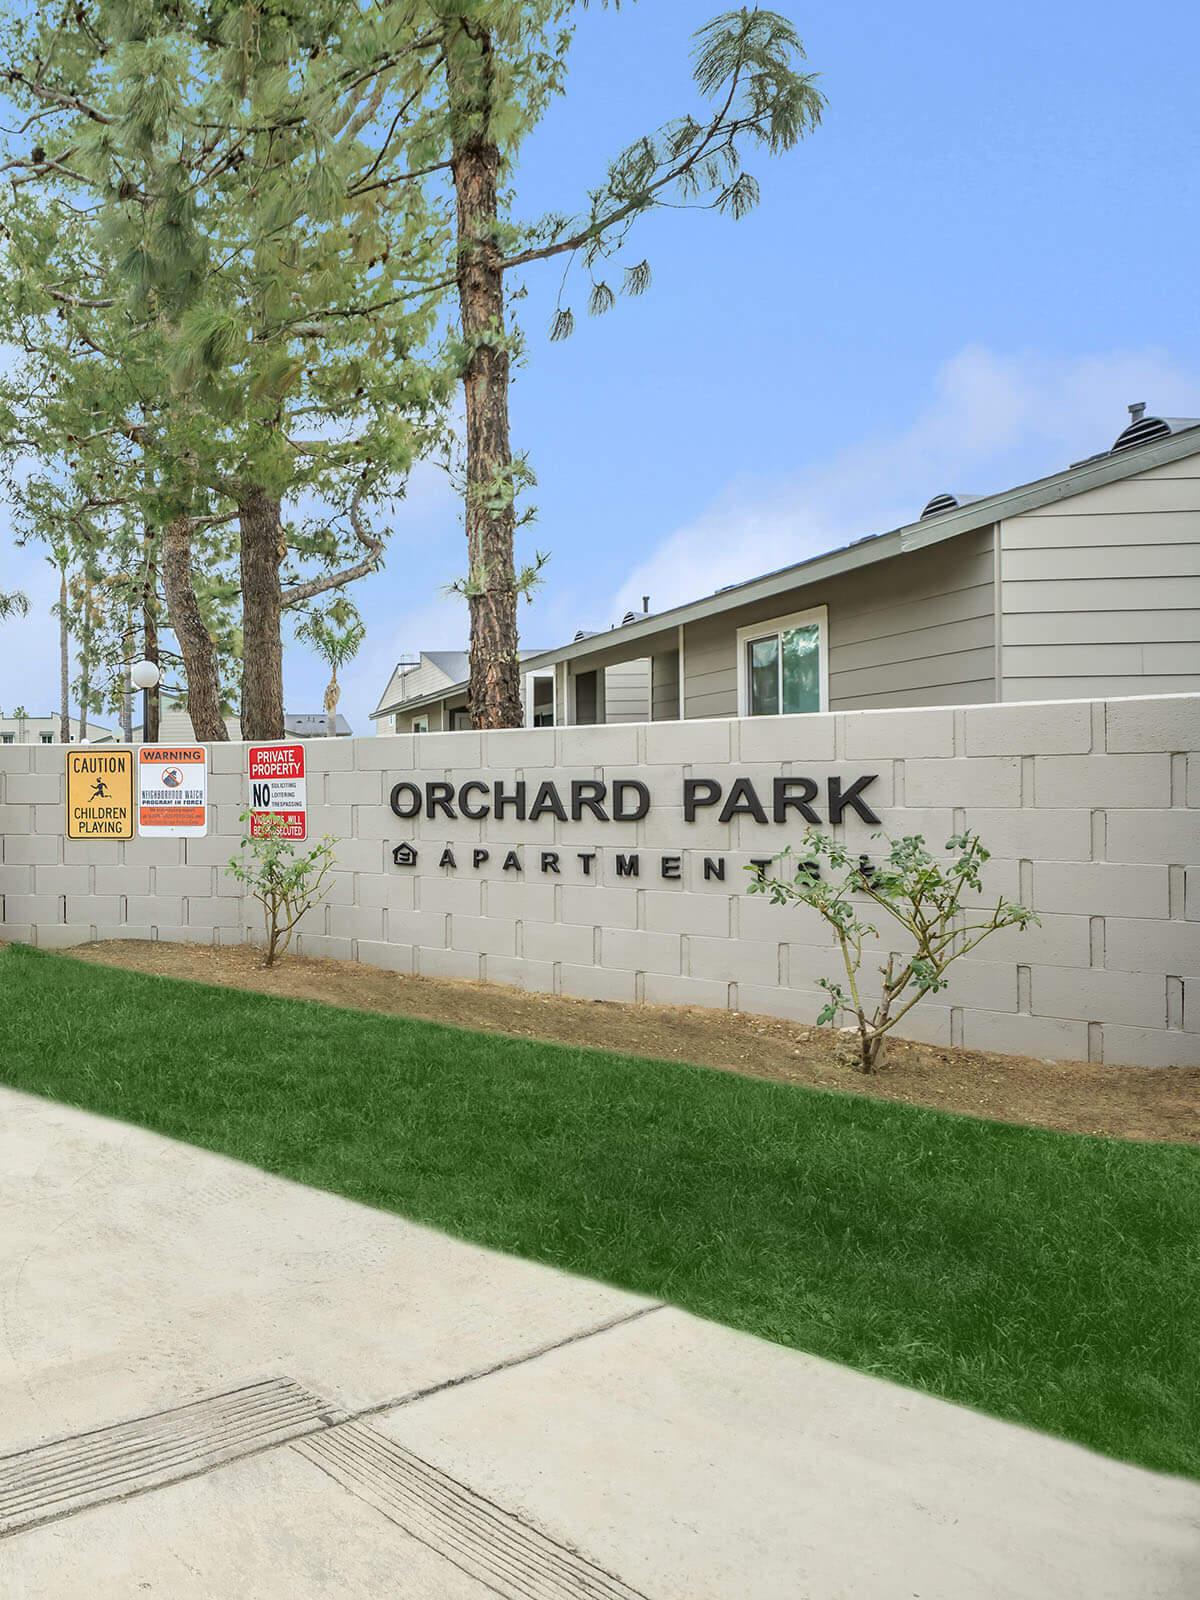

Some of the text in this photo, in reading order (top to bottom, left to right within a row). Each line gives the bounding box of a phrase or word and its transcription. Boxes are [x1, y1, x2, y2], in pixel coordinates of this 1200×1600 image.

[144, 752, 201, 760] WARNING
[258, 750, 294, 763] PRIVATE
[74, 758, 125, 773] CAUTION
[252, 763, 300, 776] PROPERTY
[142, 791, 203, 799] NEIGHBORHOOD WATCH
[253, 784, 270, 807] NO
[389, 774, 881, 824] ORCHARD PARK
[74, 808, 126, 819] CHILDREN
[79, 822, 122, 833] PLAYING
[439, 847, 821, 886] APARTMENTS
